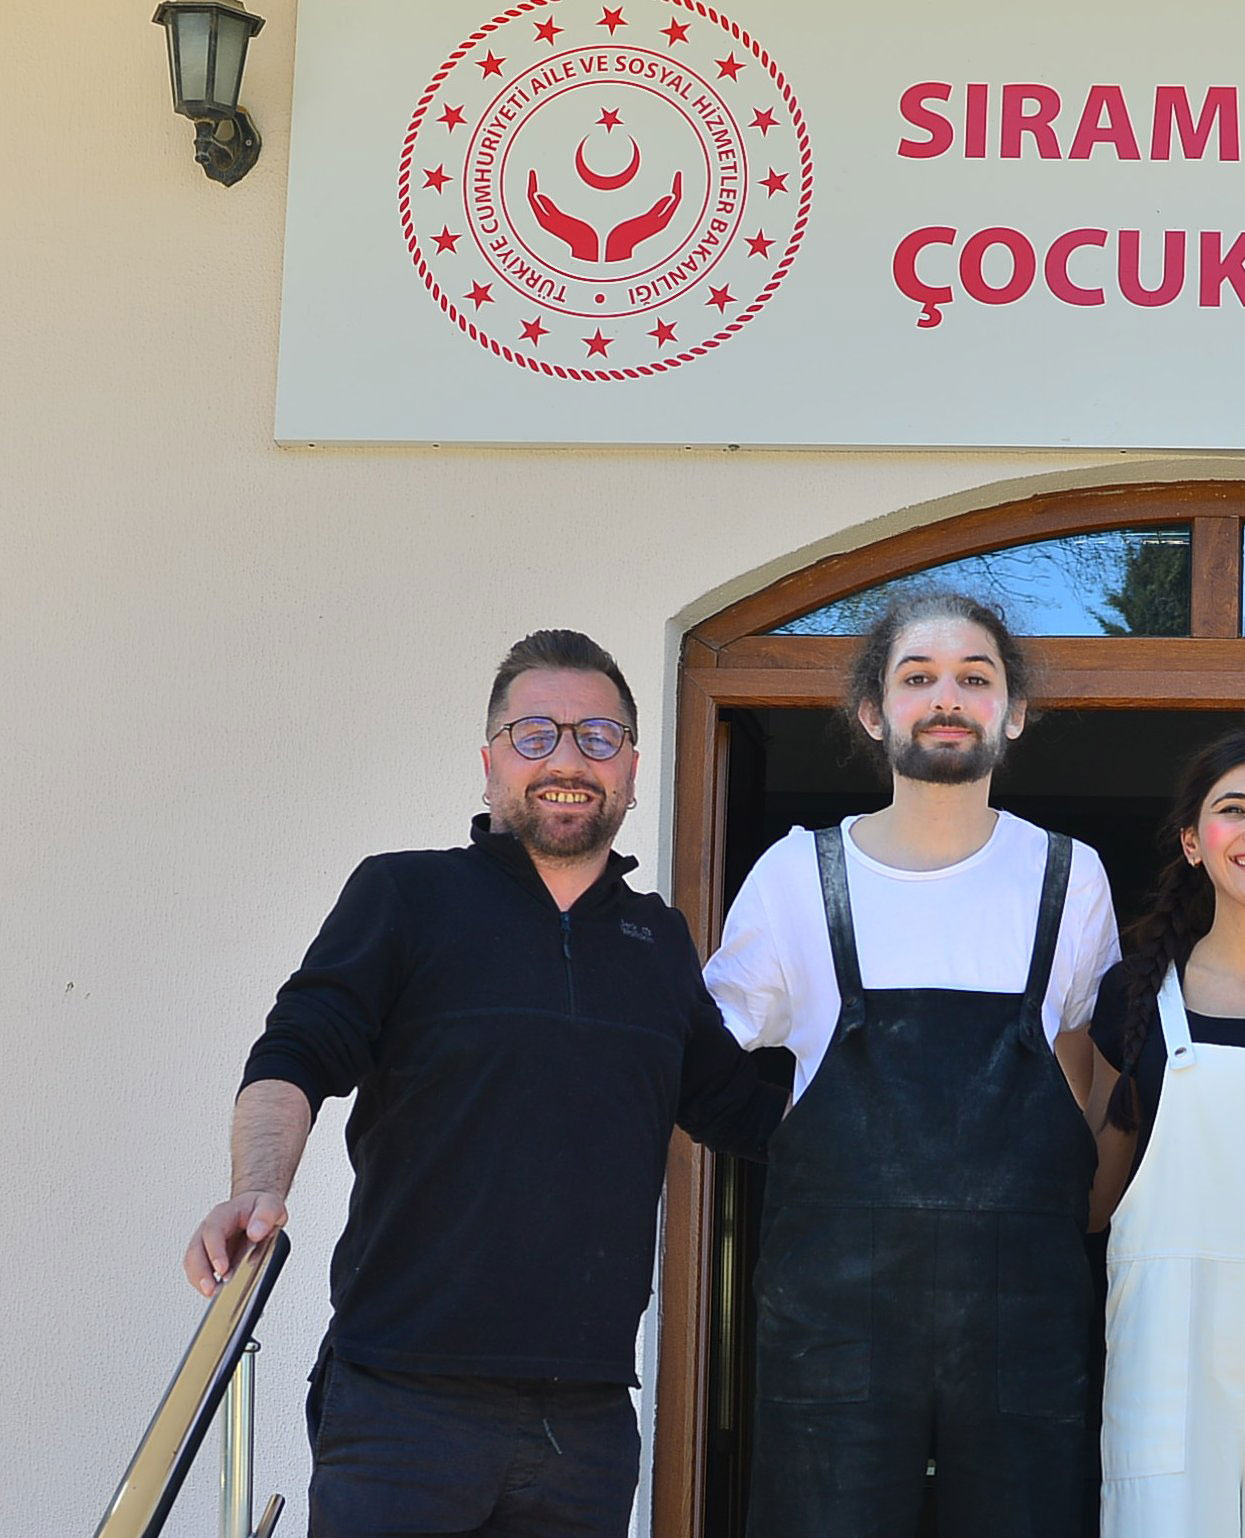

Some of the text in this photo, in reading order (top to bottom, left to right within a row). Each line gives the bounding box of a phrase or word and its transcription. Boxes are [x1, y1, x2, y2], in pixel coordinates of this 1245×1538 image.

[473, 54, 740, 306] TÜRKİYE CUMHURİYETİ AİLE VE SOSYAL HİZMETLER BAKANLIĞI
